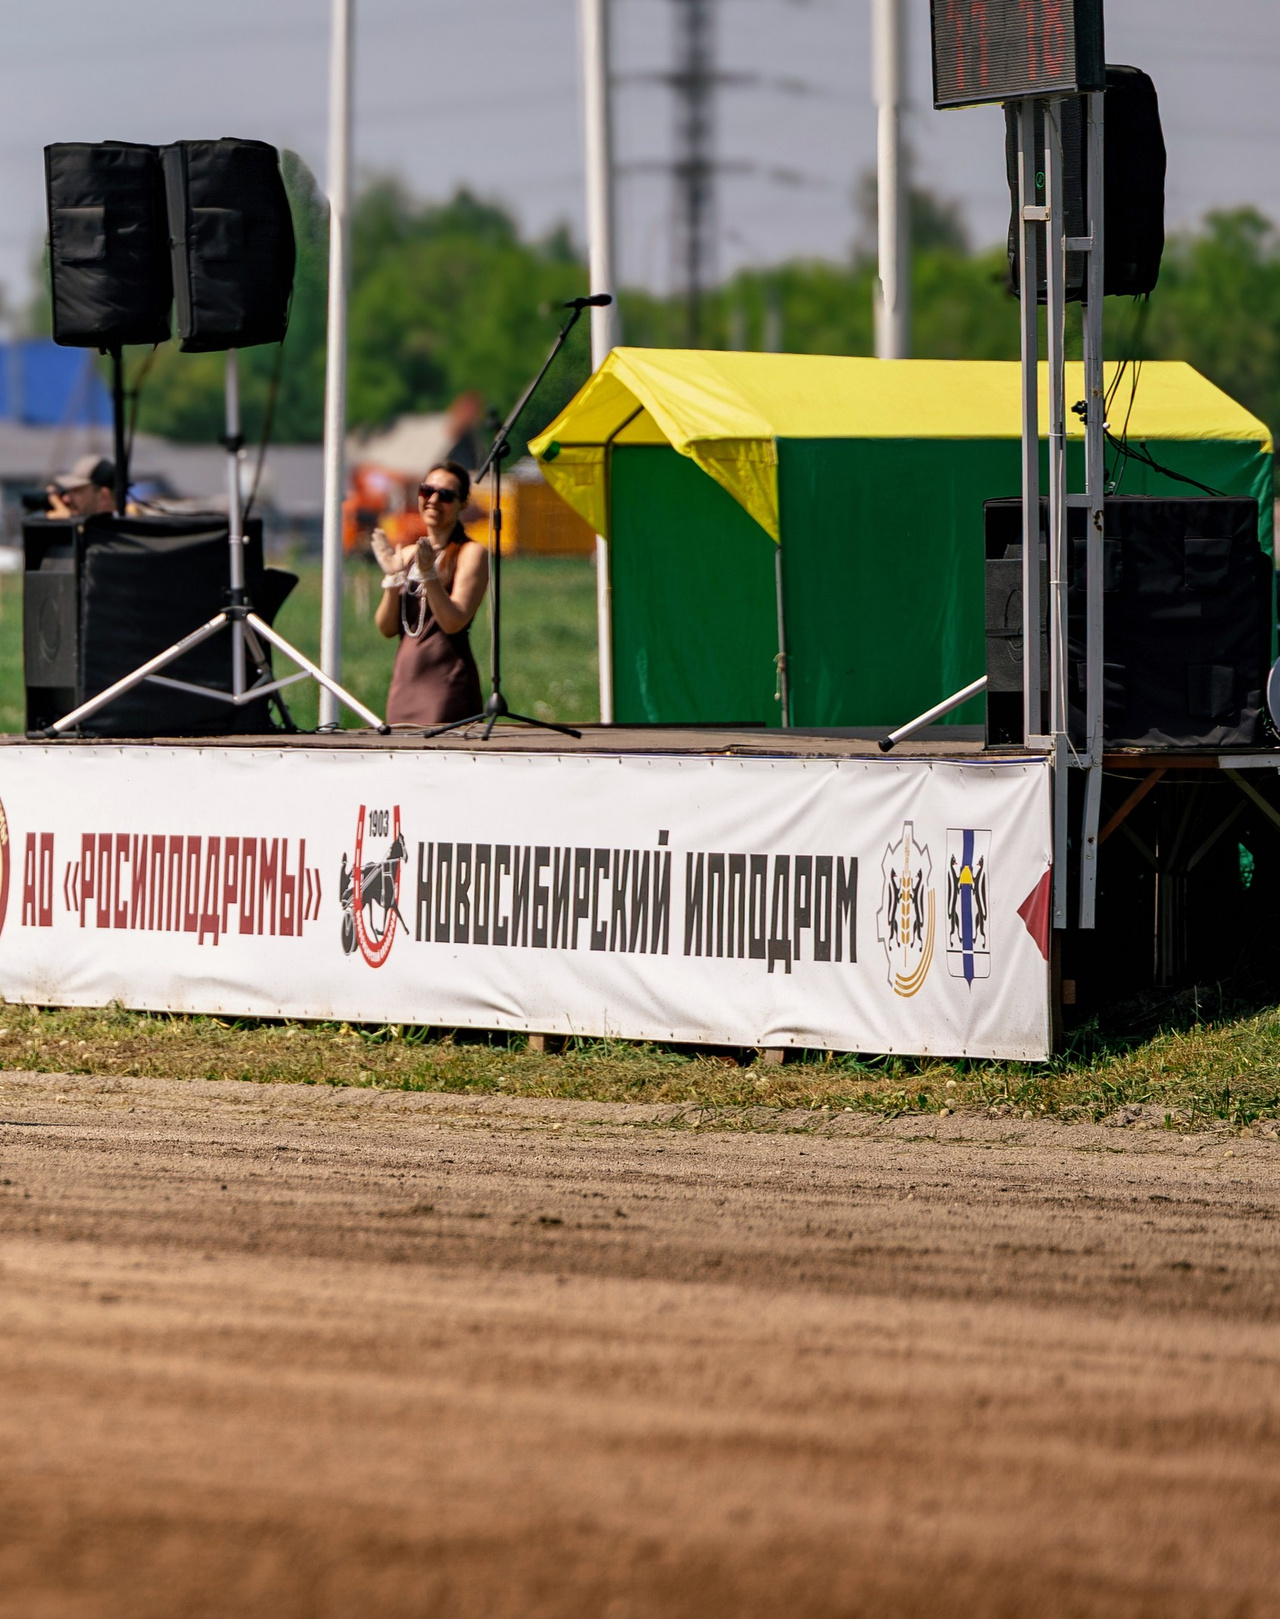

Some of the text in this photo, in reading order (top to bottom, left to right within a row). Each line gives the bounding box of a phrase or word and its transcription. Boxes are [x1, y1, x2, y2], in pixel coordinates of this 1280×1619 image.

[368, 809, 390, 838] 1903
[21, 832, 54, 927] АО
[63, 833, 322, 946] «РОСИППОДРОМЫ»
[415, 830, 672, 955] НОВОСИБИРСКИЙ
[683, 851, 859, 975] ИППОДРОМ
